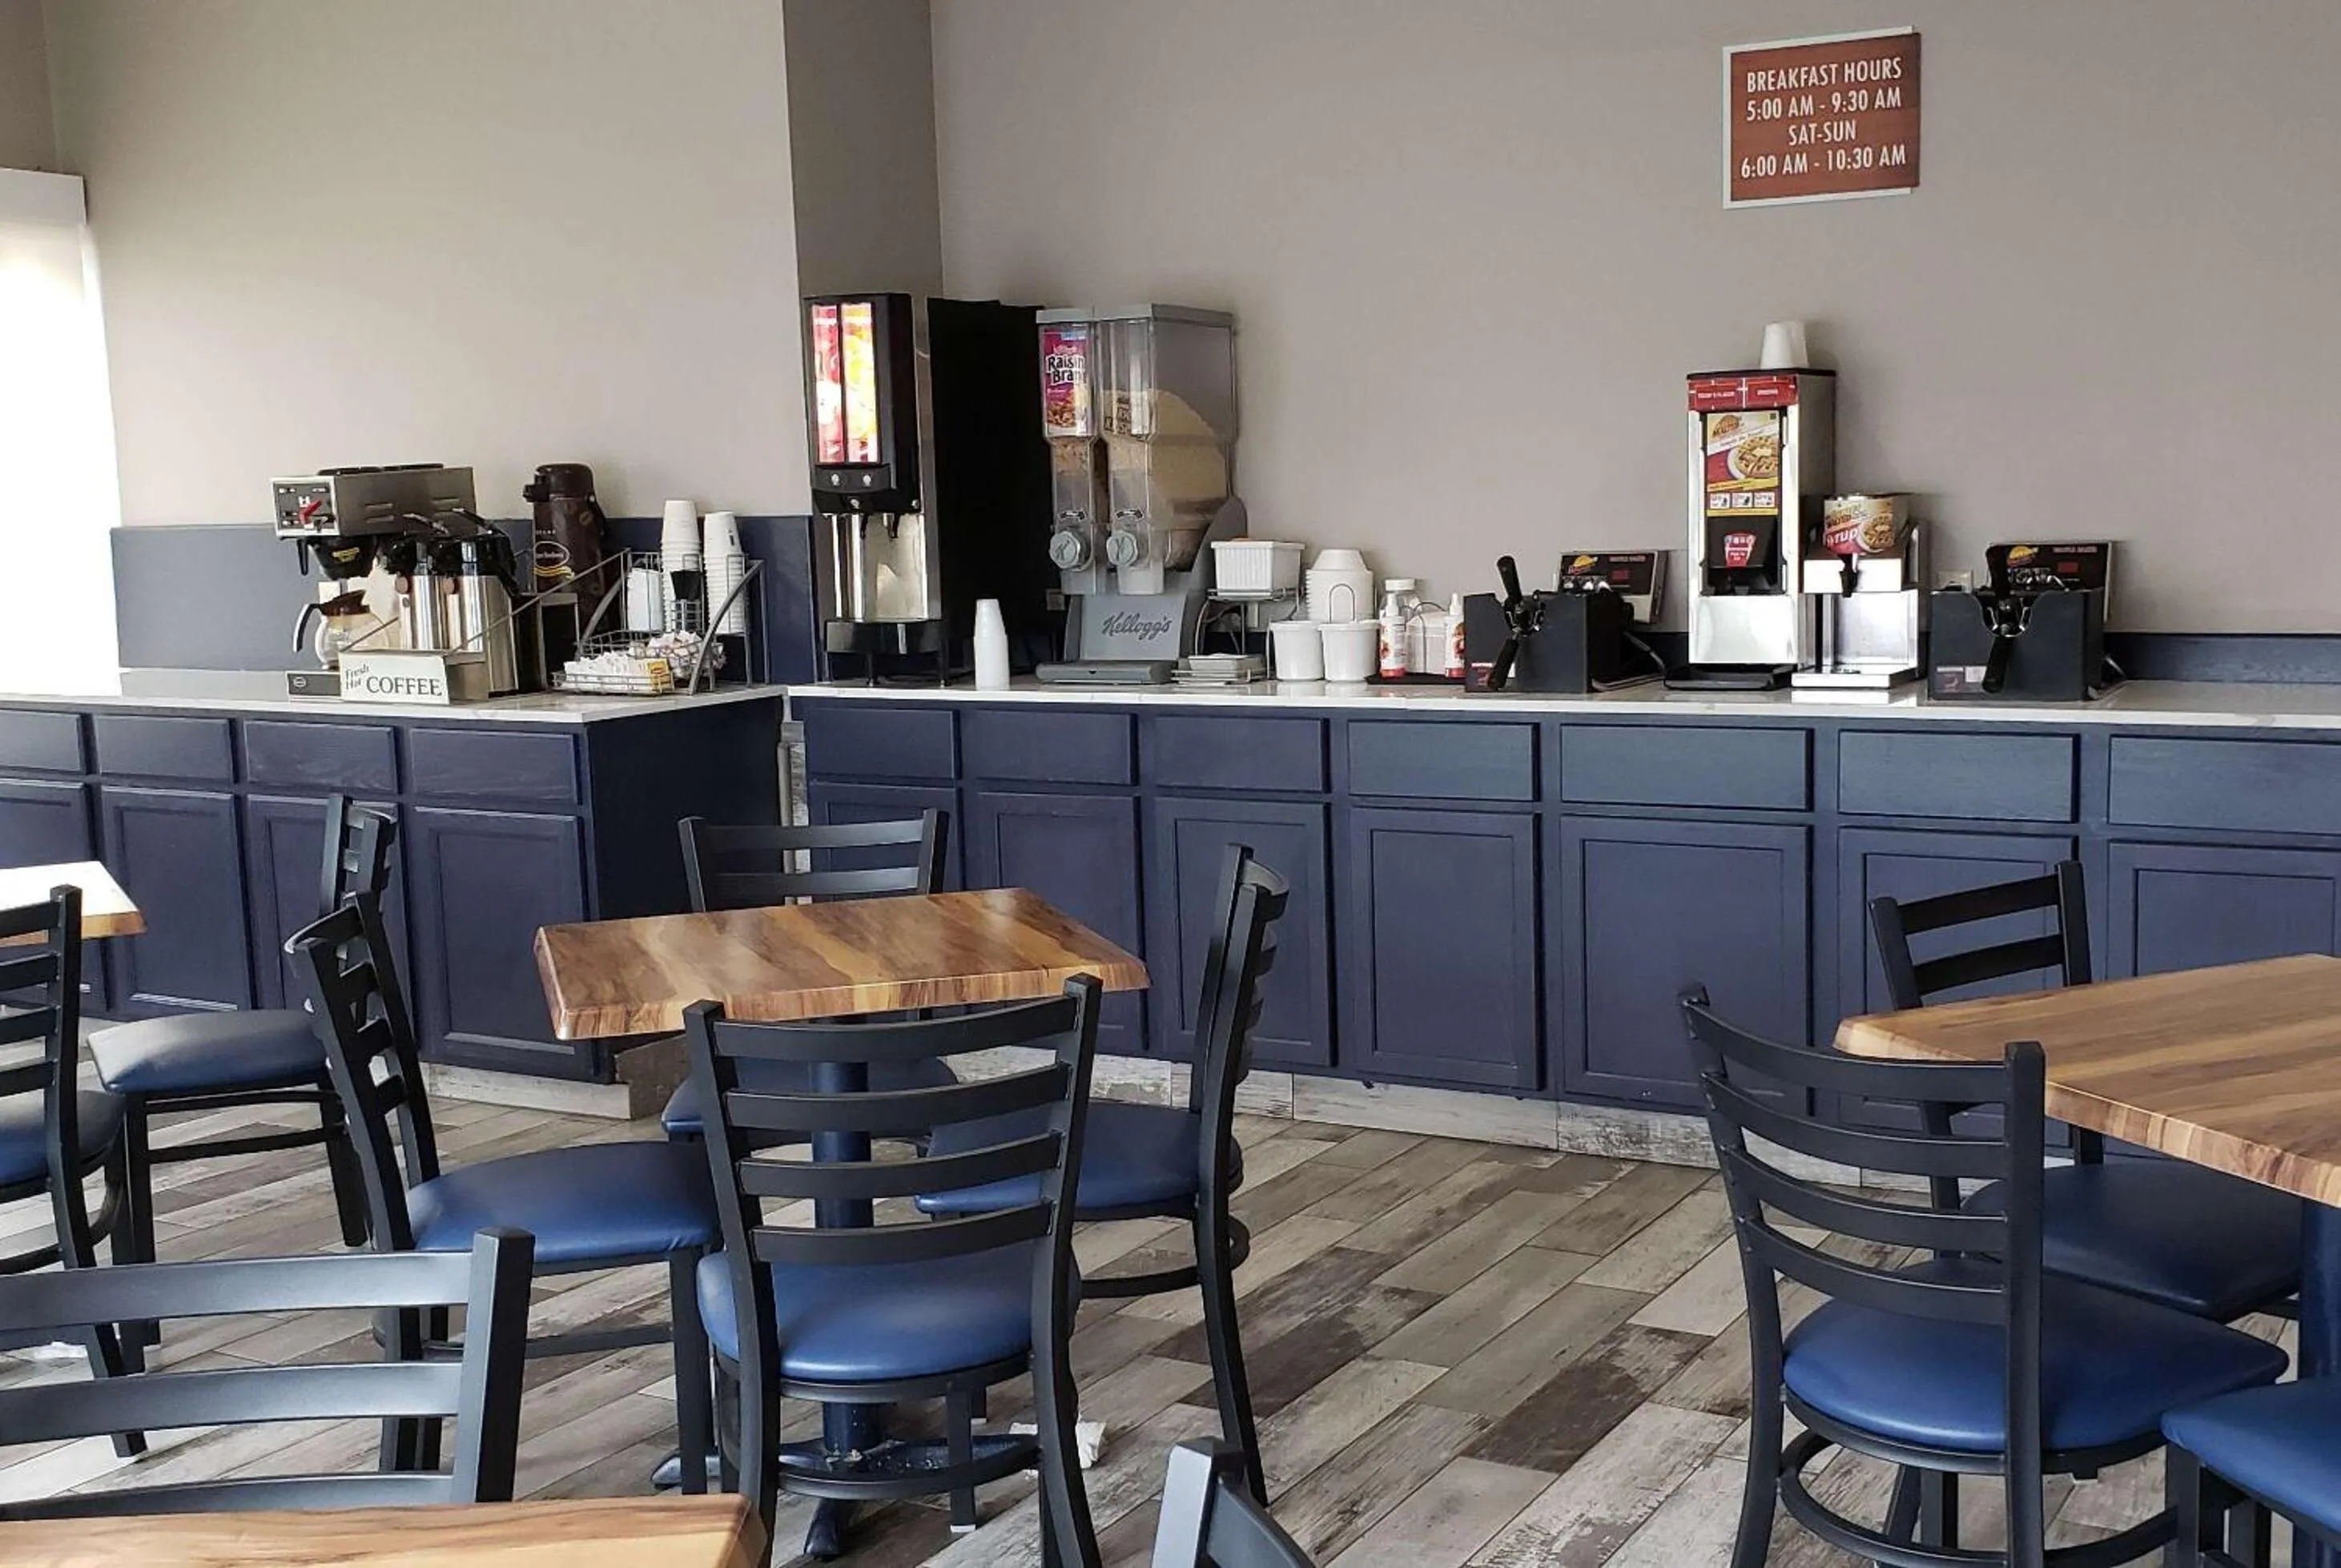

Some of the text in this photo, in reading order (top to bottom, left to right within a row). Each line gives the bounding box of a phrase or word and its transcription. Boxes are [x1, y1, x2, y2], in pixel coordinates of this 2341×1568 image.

[1747, 57, 1902, 94] BREAKFAST HOURS
[1746, 98, 1782, 121] 5:00
[1788, 94, 1814, 118] AM
[1832, 90, 1868, 113] 9:30
[1874, 86, 1902, 110] AM
[1788, 120, 1856, 146] SAT-SUN
[1741, 155, 1777, 179] 6:00
[1782, 153, 1808, 175] AM
[1827, 147, 1873, 171] 10:30
[1879, 144, 1906, 167] AM
[1048, 355, 1084, 372] Raisin
[1052, 369, 1087, 384] Bran
[1101, 611, 1173, 641] Kellogg's
[366, 676, 443, 697] COFFEE
